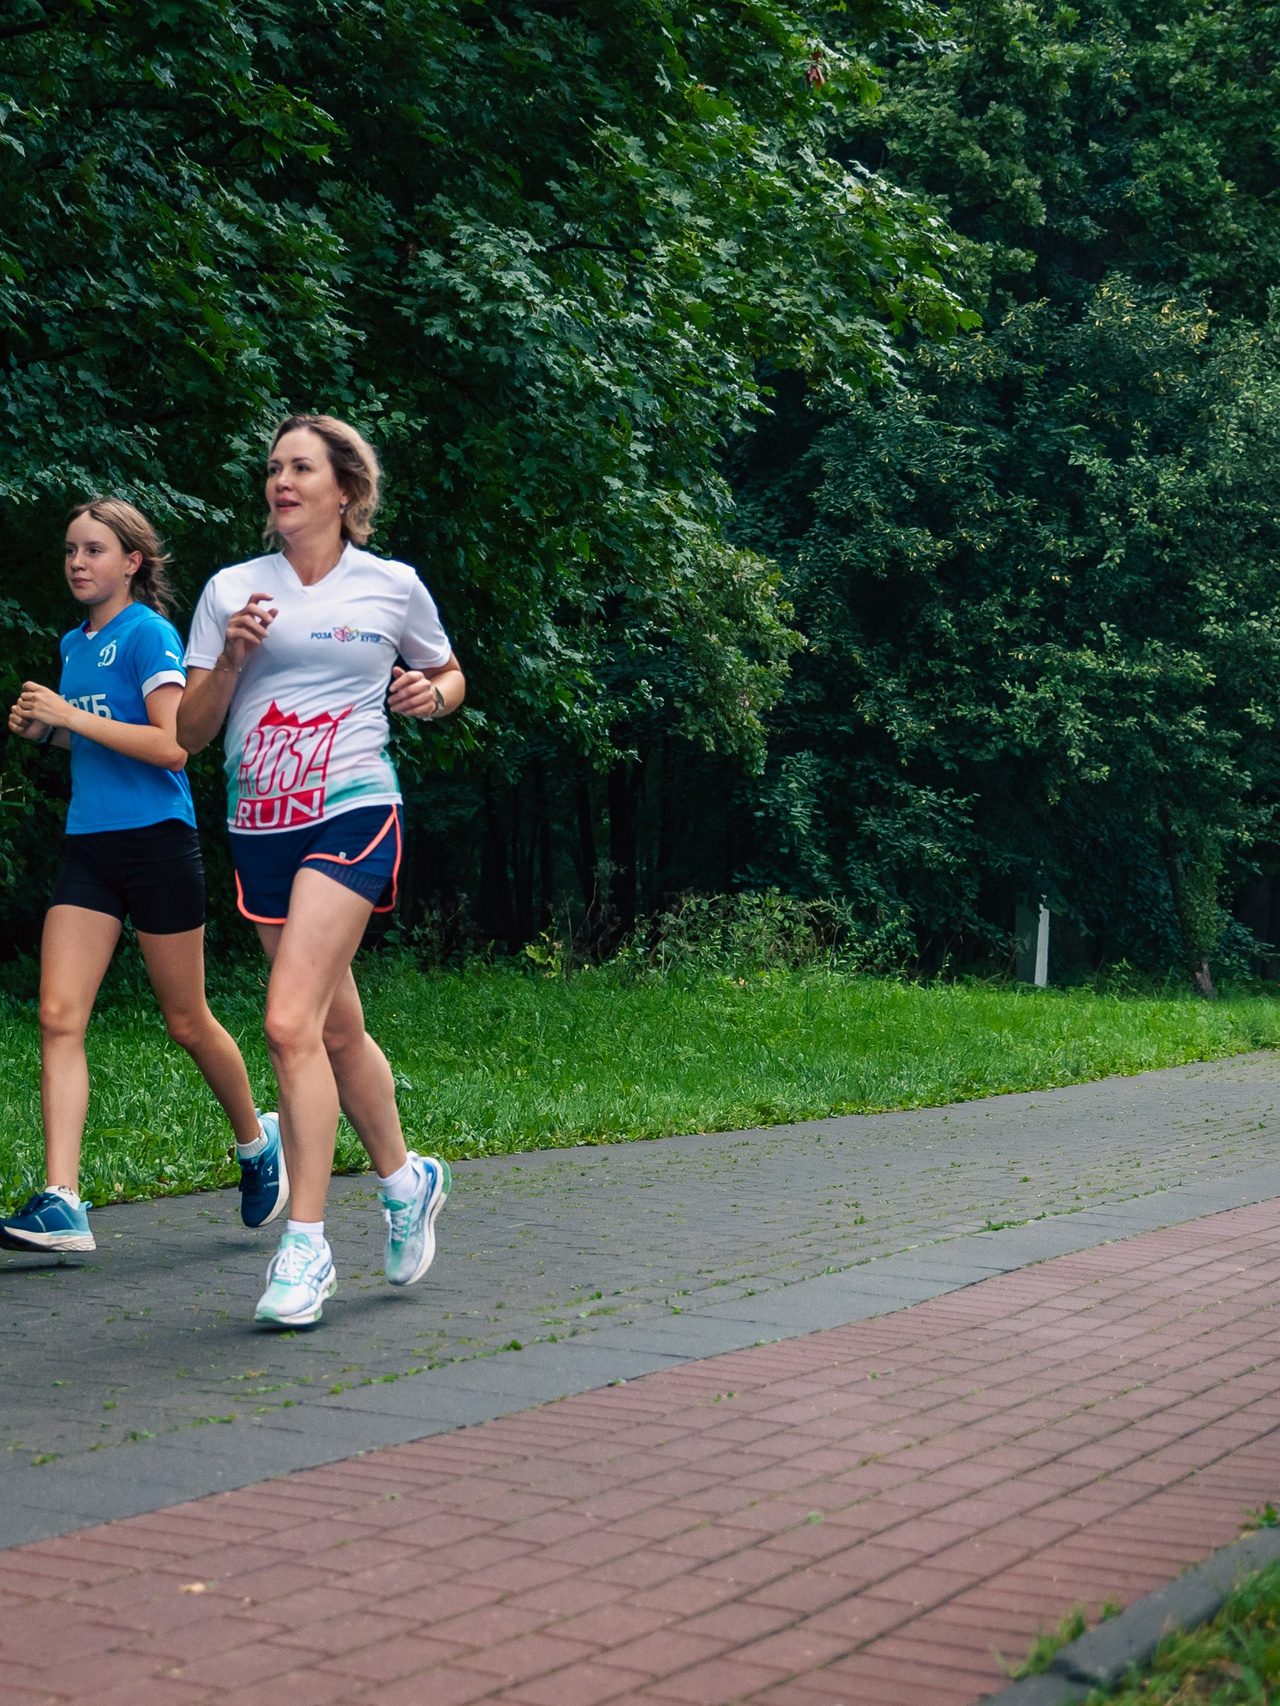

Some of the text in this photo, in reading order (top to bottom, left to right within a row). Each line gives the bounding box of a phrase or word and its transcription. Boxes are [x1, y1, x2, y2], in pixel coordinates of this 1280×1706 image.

[310, 632, 333, 640] РОЗА
[238, 723, 339, 796] ROSA
[236, 790, 321, 828] RUN
